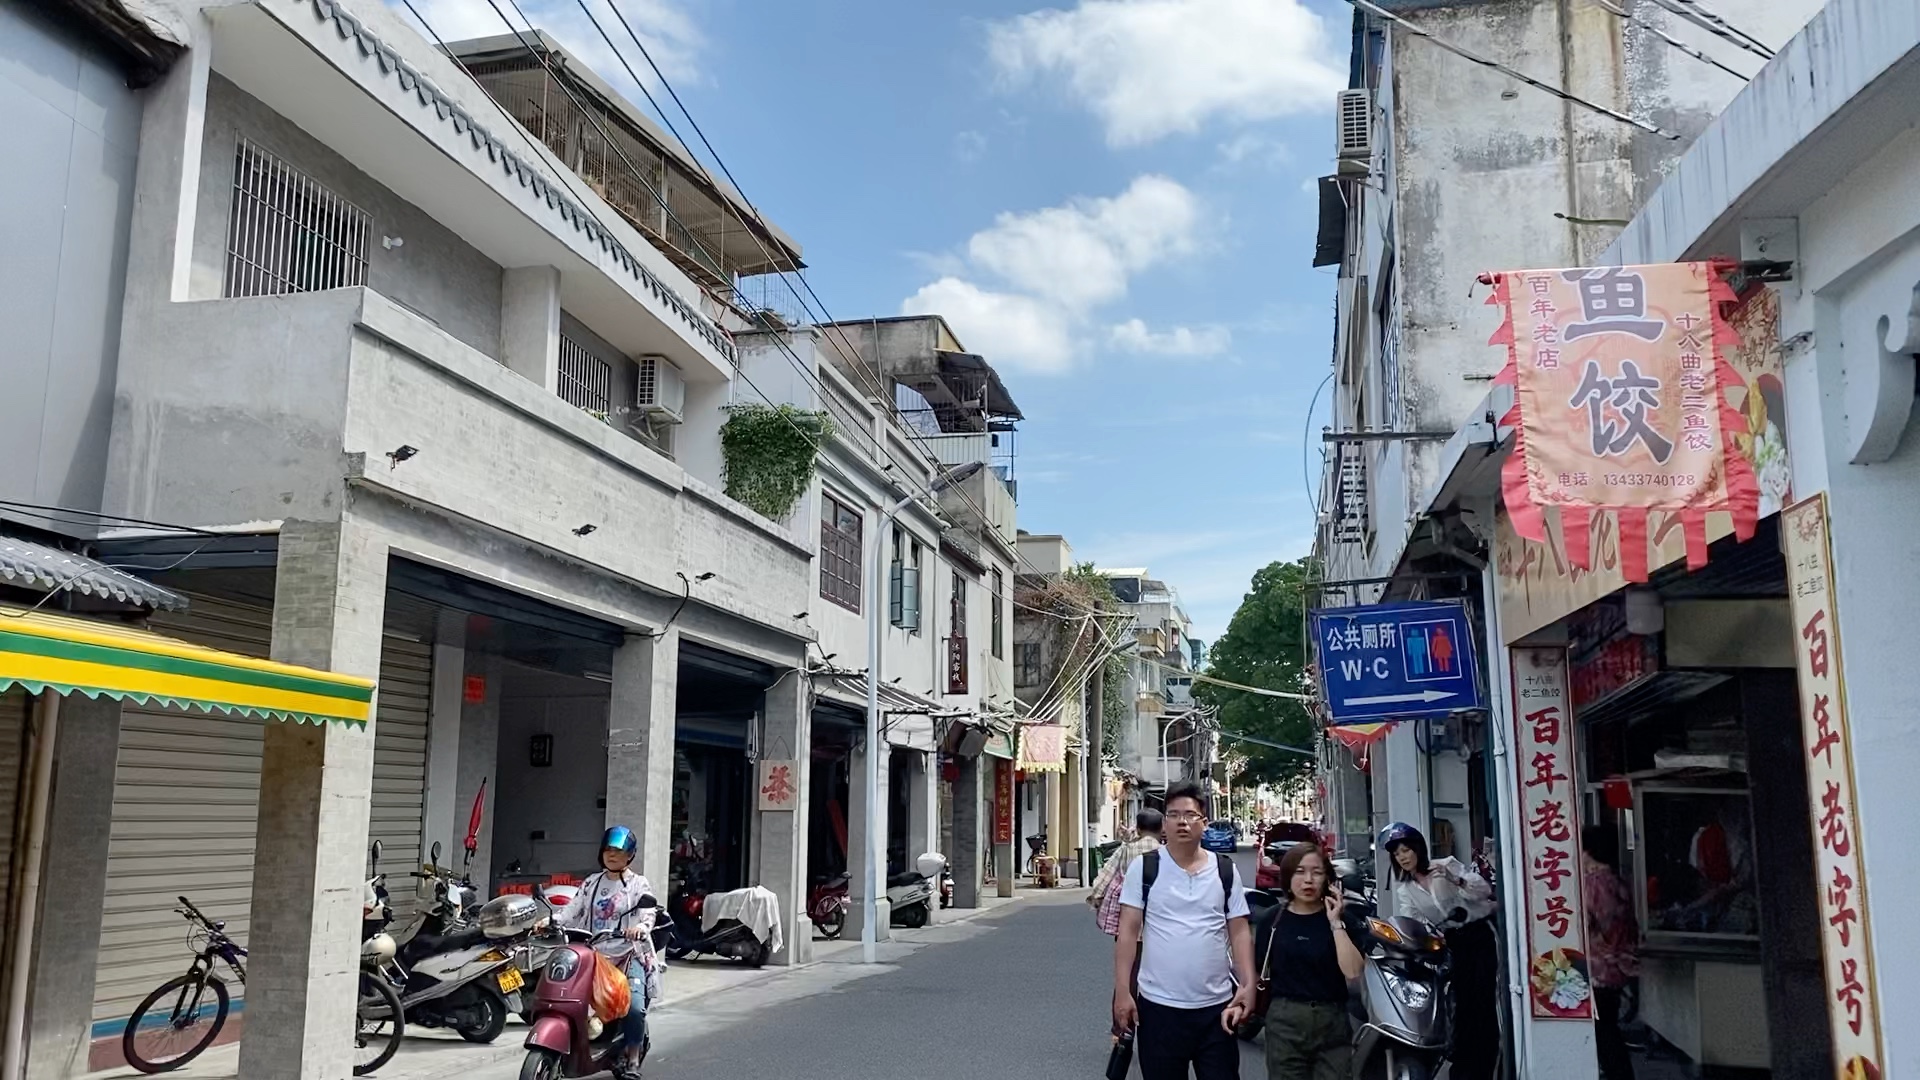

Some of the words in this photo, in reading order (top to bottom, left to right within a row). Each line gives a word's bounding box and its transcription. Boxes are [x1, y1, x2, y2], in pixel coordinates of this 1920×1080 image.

[1527, 275, 1560, 369] 百年老店
[1562, 267, 1673, 465] 鱼饺
[1675, 313, 1713, 451] 十八曲老二鱼饺
[1603, 473, 1696, 487] 13433740128
[1327, 623, 1396, 651] 公共厕所
[1525, 706, 1574, 939] 百年老字号
[1802, 609, 1865, 1037] 百年老字号
